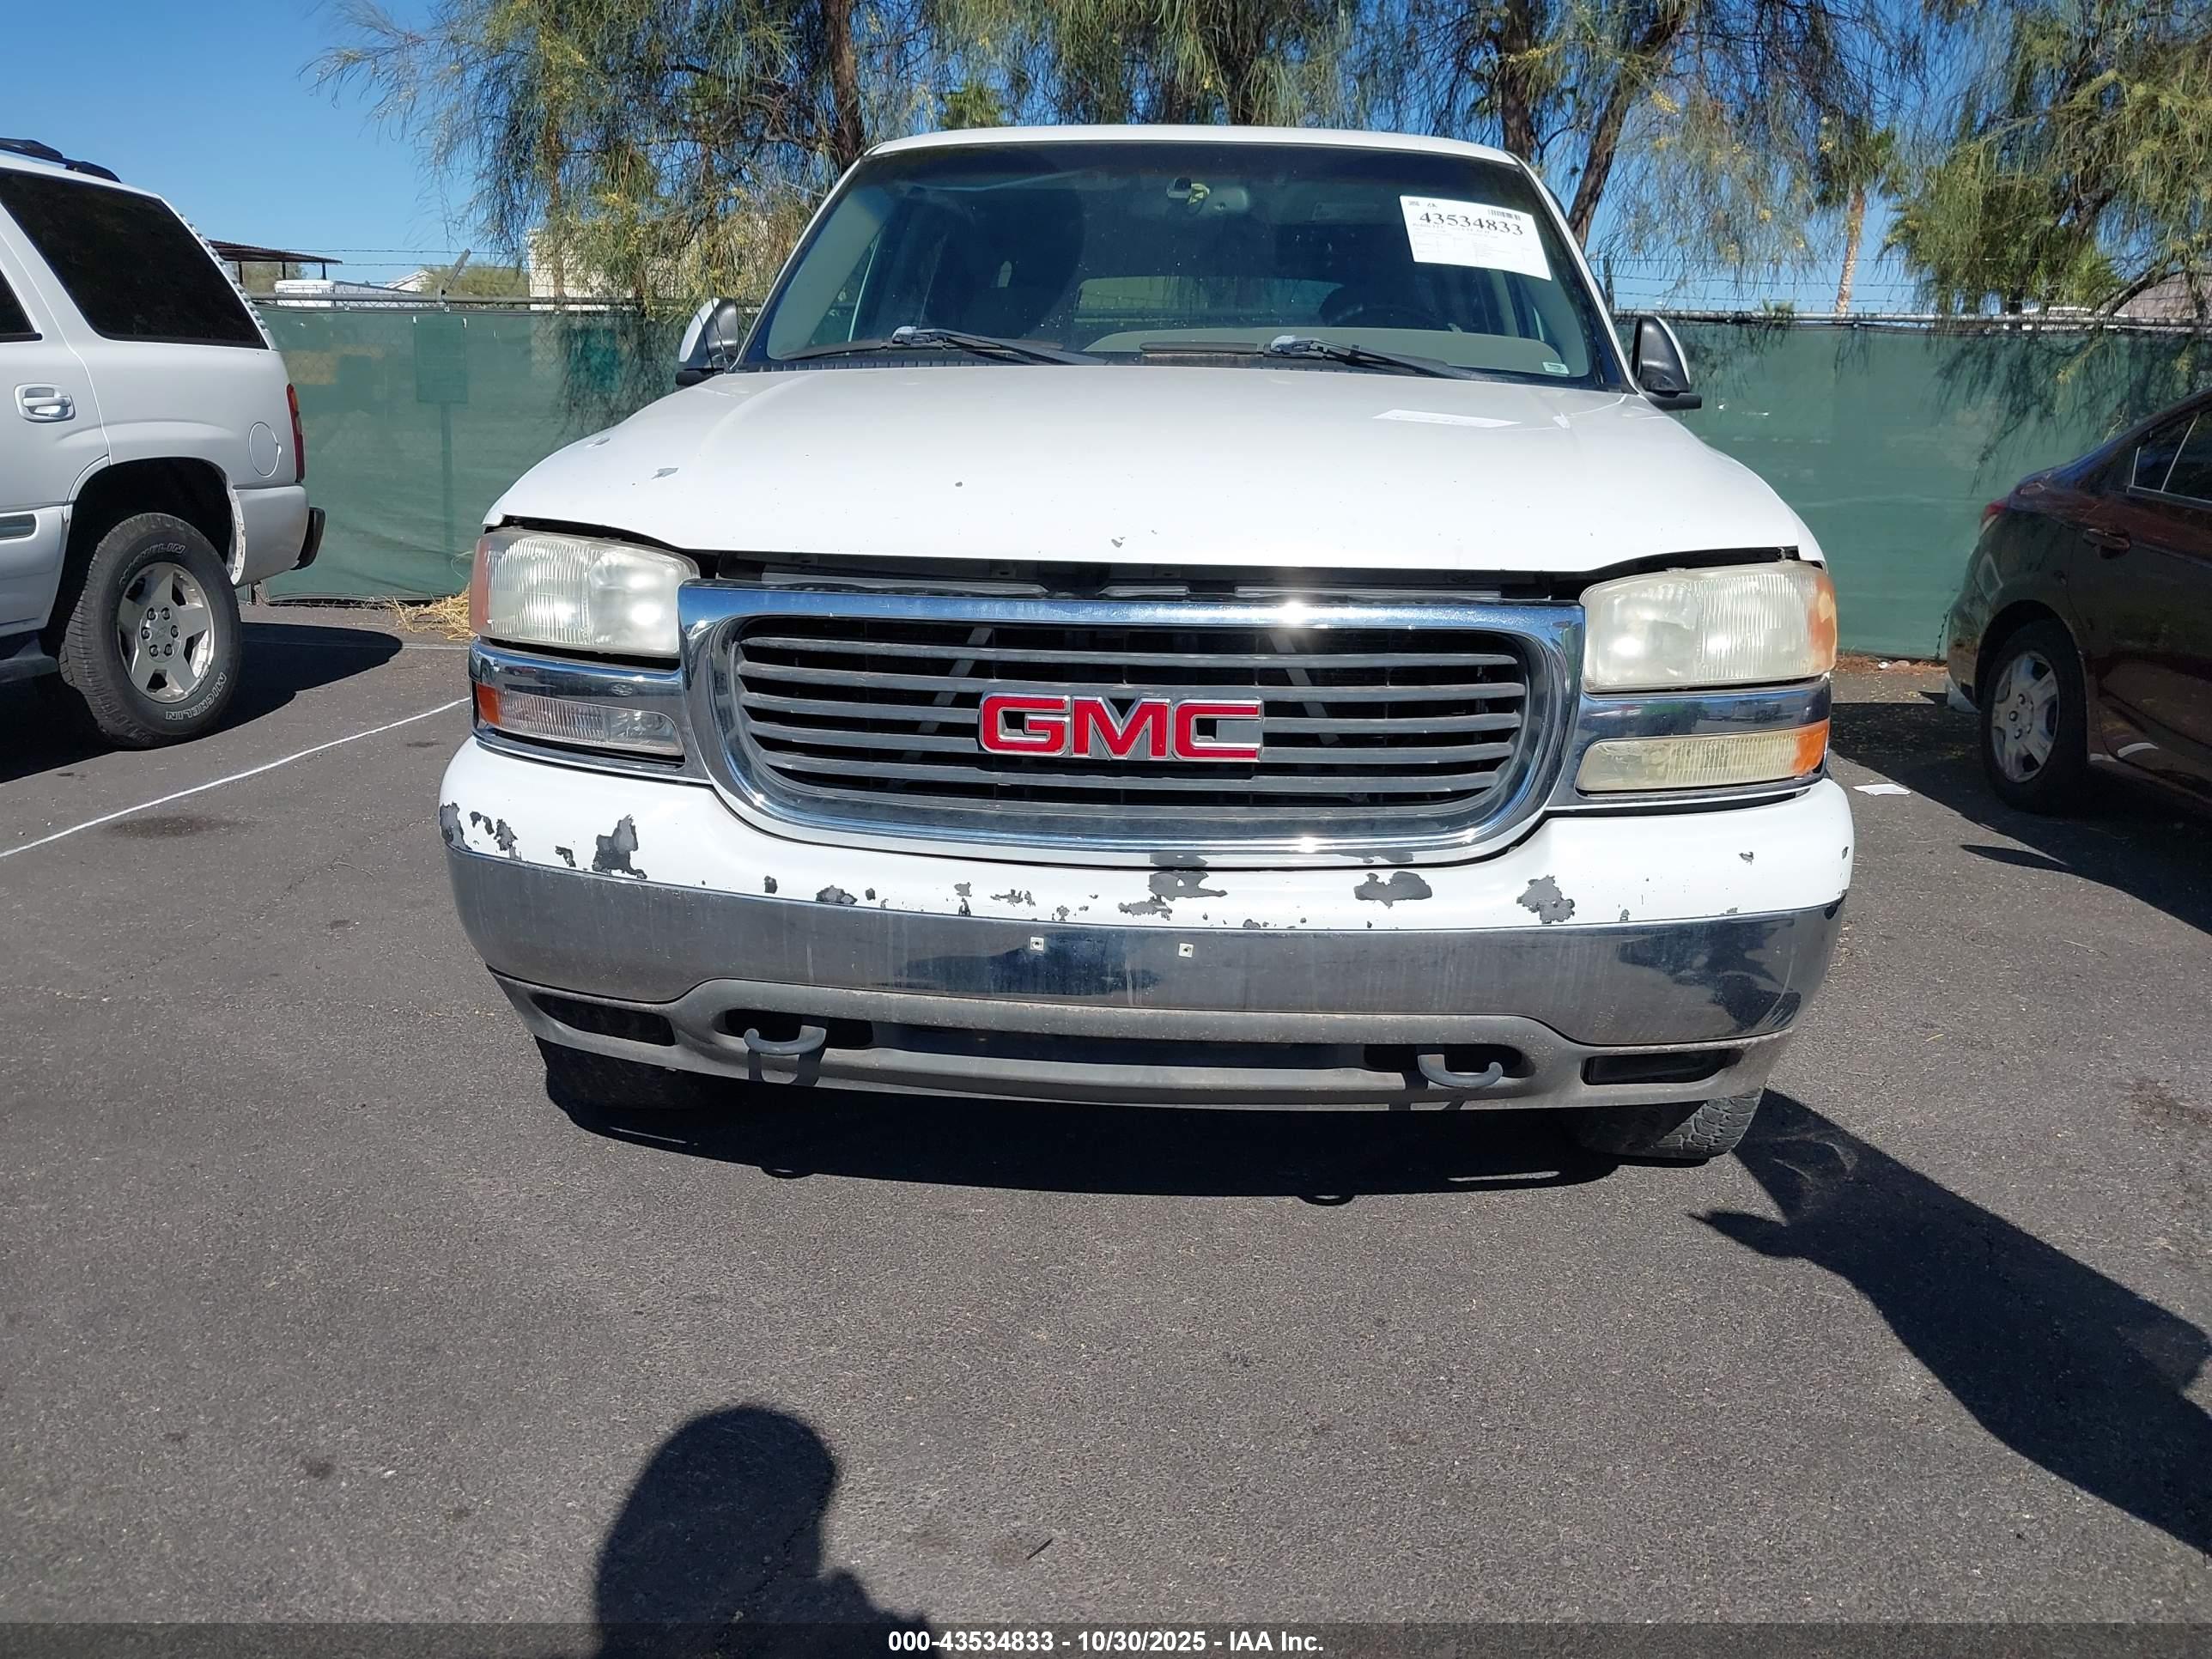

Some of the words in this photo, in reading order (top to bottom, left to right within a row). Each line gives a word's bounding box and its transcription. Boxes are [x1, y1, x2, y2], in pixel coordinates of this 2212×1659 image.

[1419, 212, 1523, 236] 43534833
[118, 542, 186, 585] HELIN
[165, 672, 228, 720] MICHELIN
[979, 691, 1264, 763] GMC
